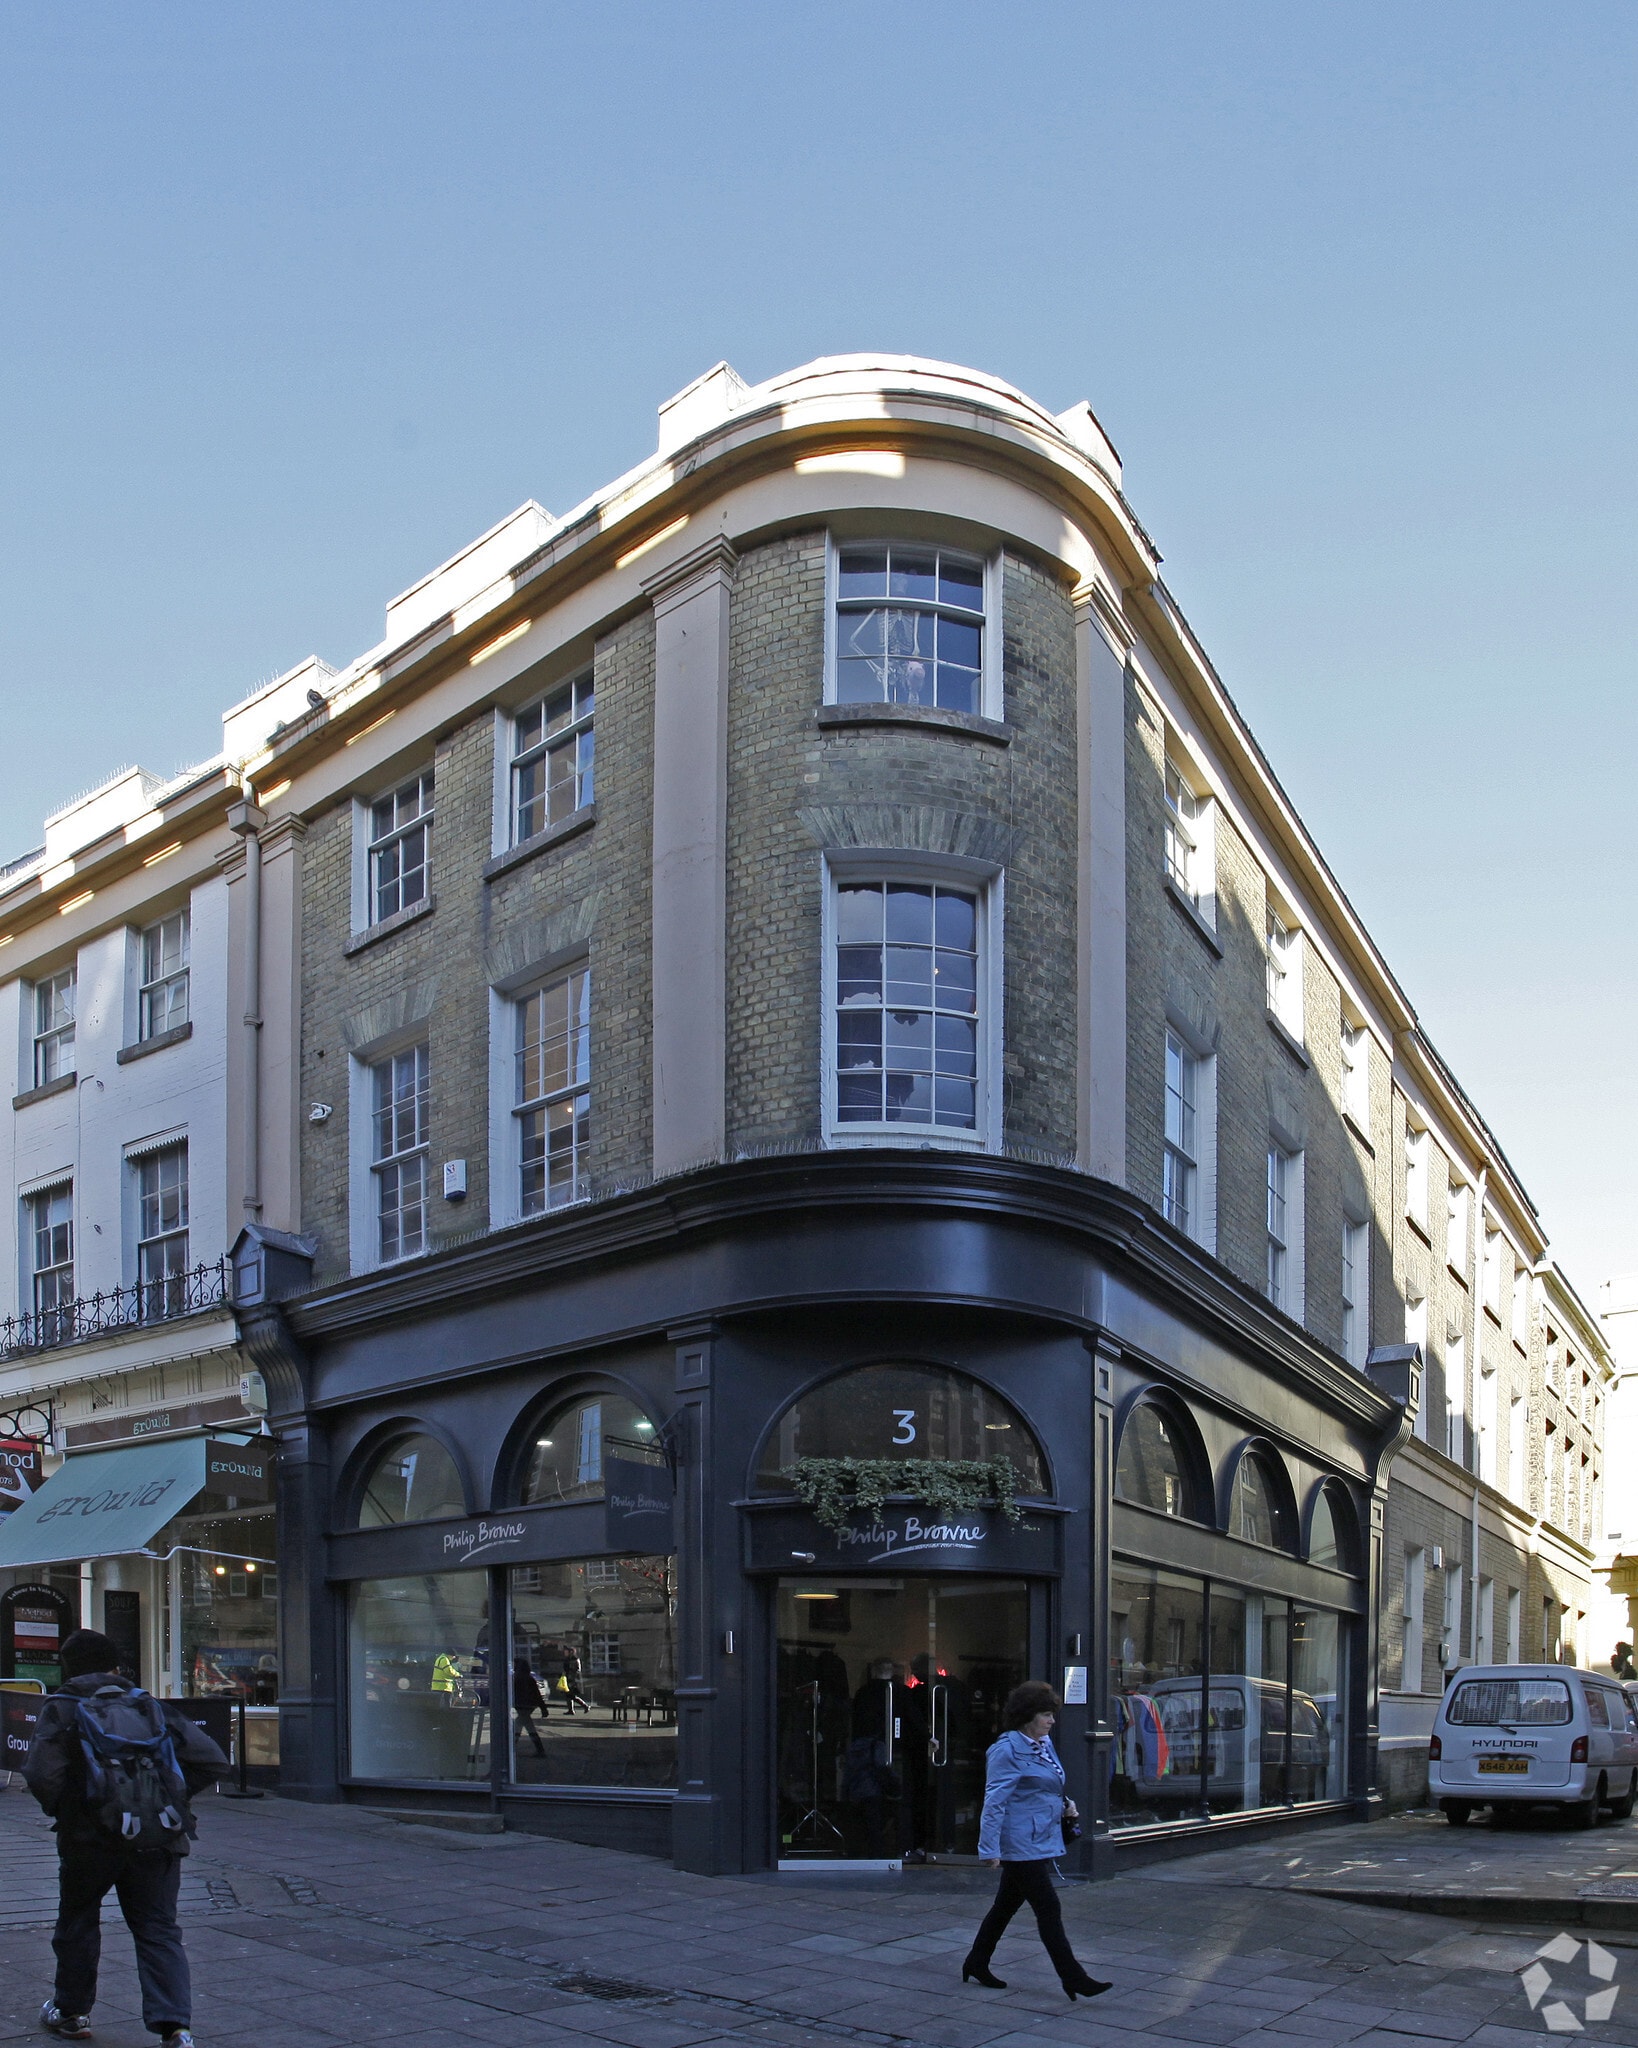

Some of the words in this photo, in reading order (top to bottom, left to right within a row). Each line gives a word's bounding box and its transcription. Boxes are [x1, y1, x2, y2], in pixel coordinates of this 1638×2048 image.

[892, 1409, 917, 1445] 3
[443, 1530, 476, 1554] Philip
[478, 1521, 528, 1542] Browne
[837, 1524, 898, 1551] Philip
[904, 1516, 988, 1542] Browne
[7, 1734, 30, 1751] Grou
[1472, 1739, 1538, 1748] HYUNDAI
